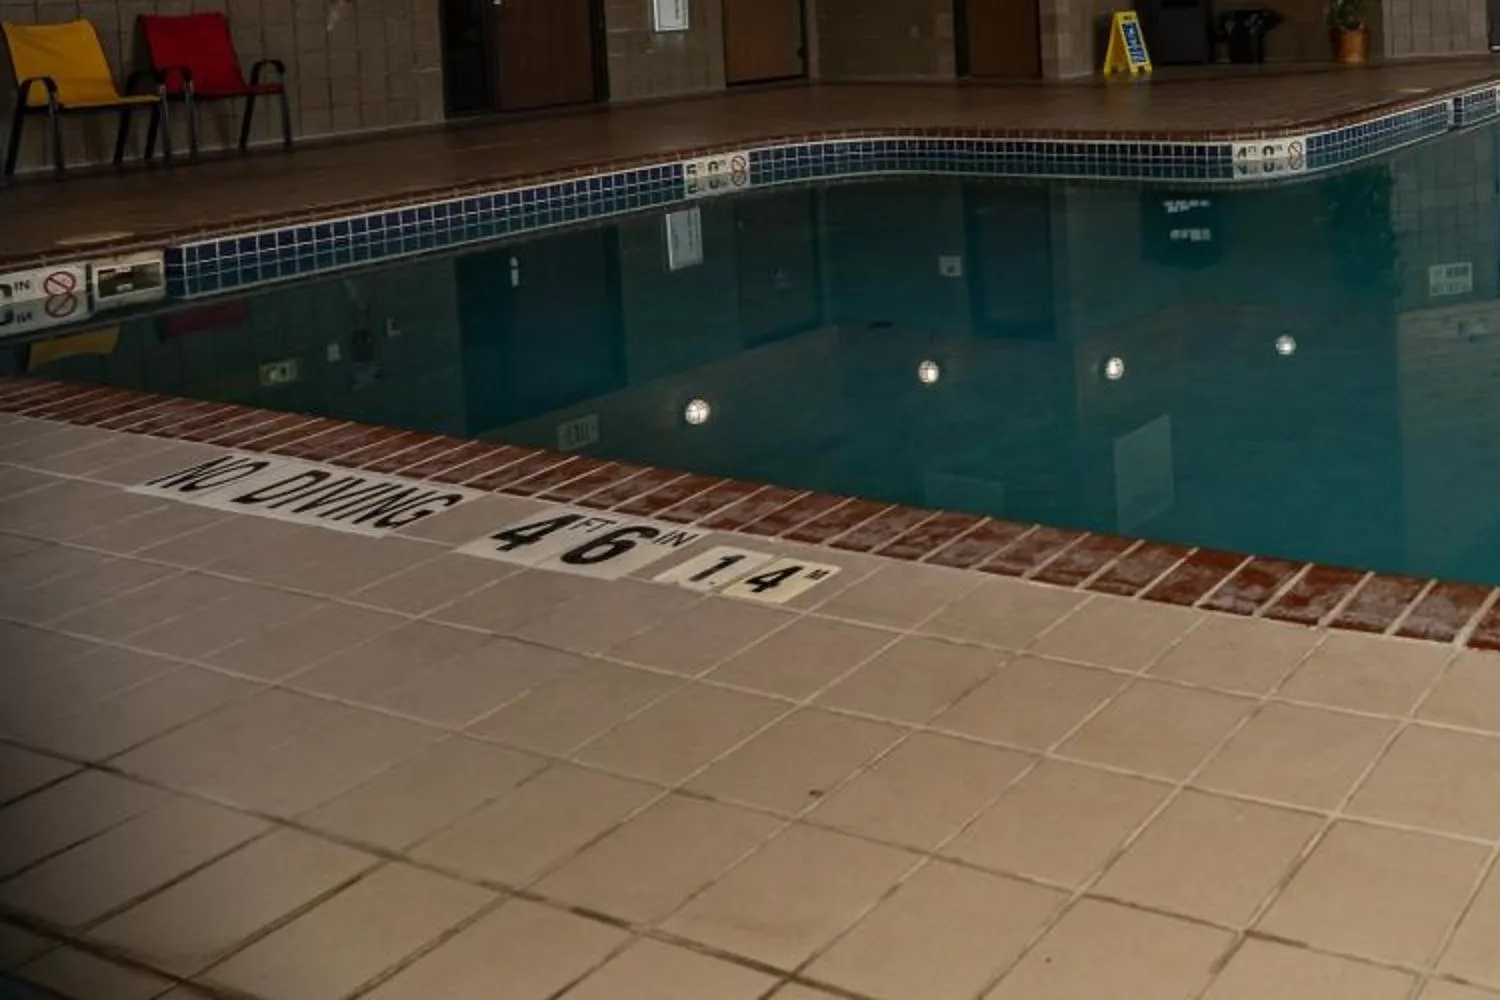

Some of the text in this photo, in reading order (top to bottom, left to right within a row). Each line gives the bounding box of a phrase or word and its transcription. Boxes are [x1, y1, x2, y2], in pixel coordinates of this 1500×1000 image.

[145, 456, 464, 529] NO DIVING
[489, 513, 699, 565] 4 FT 6 IN
